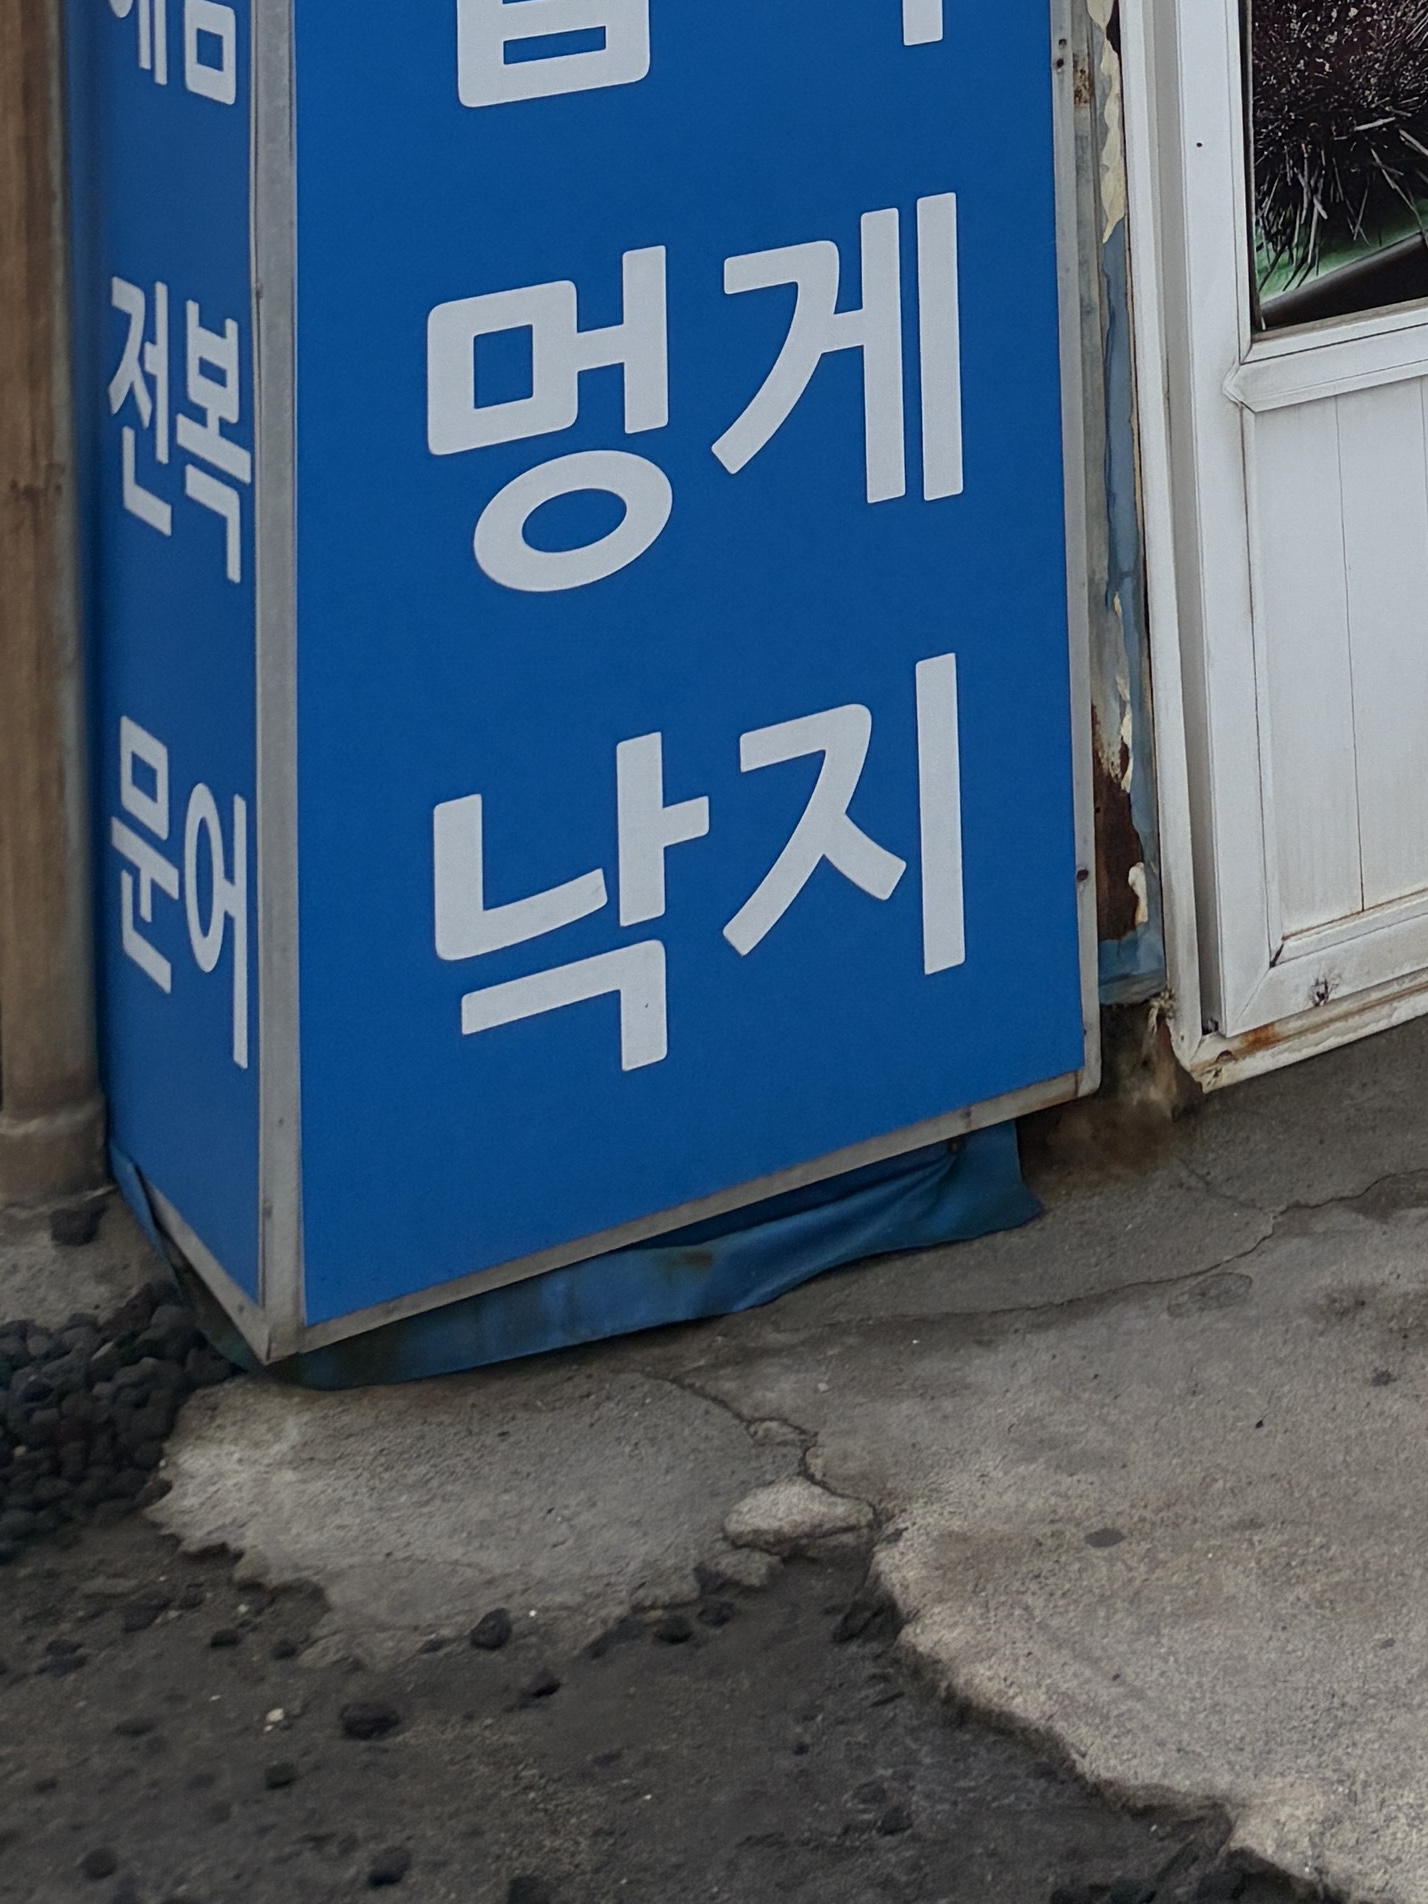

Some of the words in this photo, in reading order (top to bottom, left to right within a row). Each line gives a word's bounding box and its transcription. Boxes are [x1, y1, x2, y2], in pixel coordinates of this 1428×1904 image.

[107, 275, 252, 583] 전복
[426, 192, 963, 592] 멍게
[110, 714, 248, 1070] 문어
[432, 652, 966, 1071] 낙지
